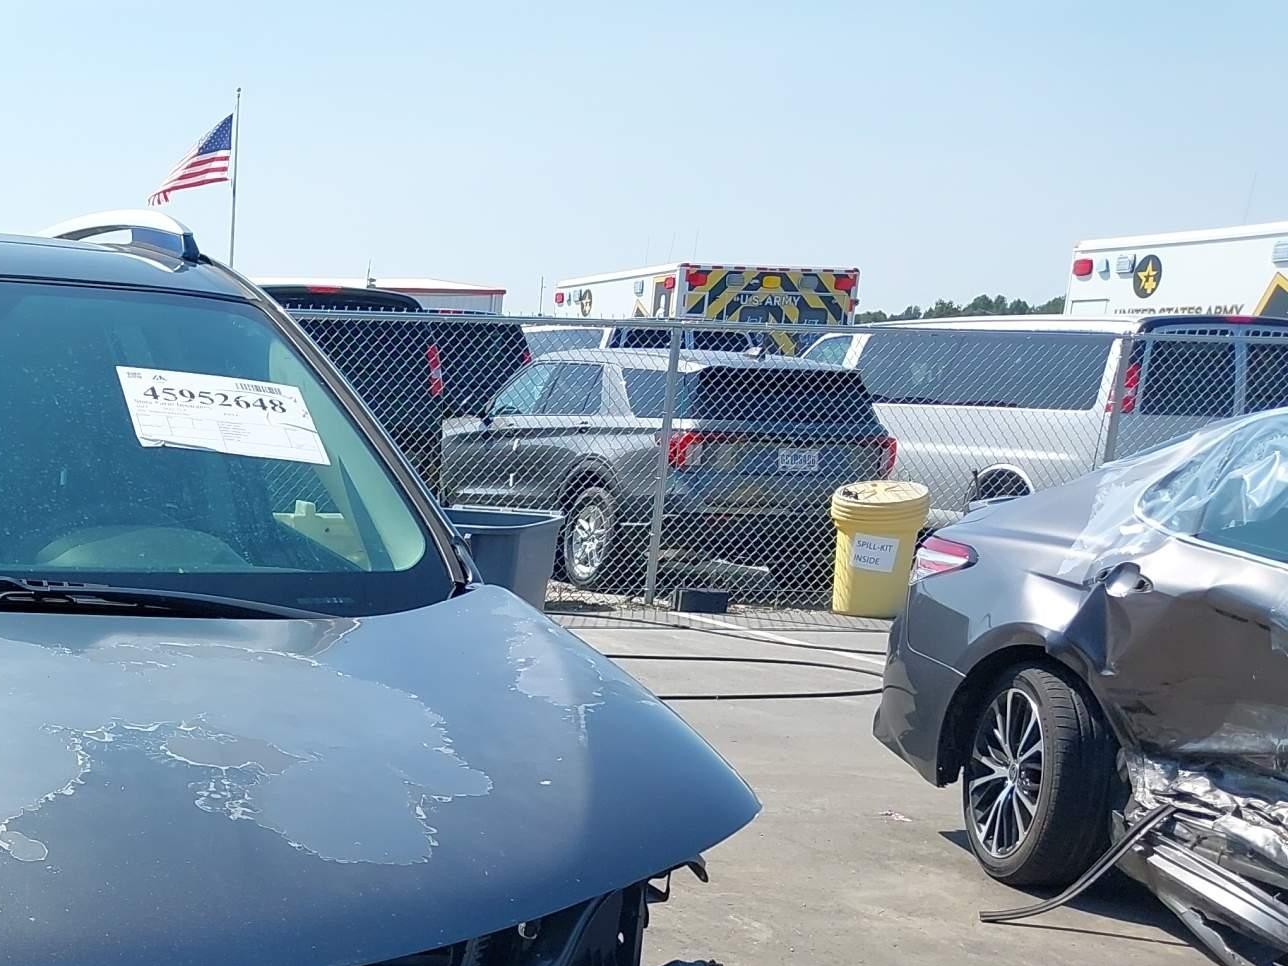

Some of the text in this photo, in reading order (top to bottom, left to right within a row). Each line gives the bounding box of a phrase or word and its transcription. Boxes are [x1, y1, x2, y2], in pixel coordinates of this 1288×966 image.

[740, 295, 801, 306] U.S. ARMY
[143, 385, 287, 414] 45952648
[856, 539, 894, 553] SPILL-KIT
[853, 554, 880, 566] INSIDE
